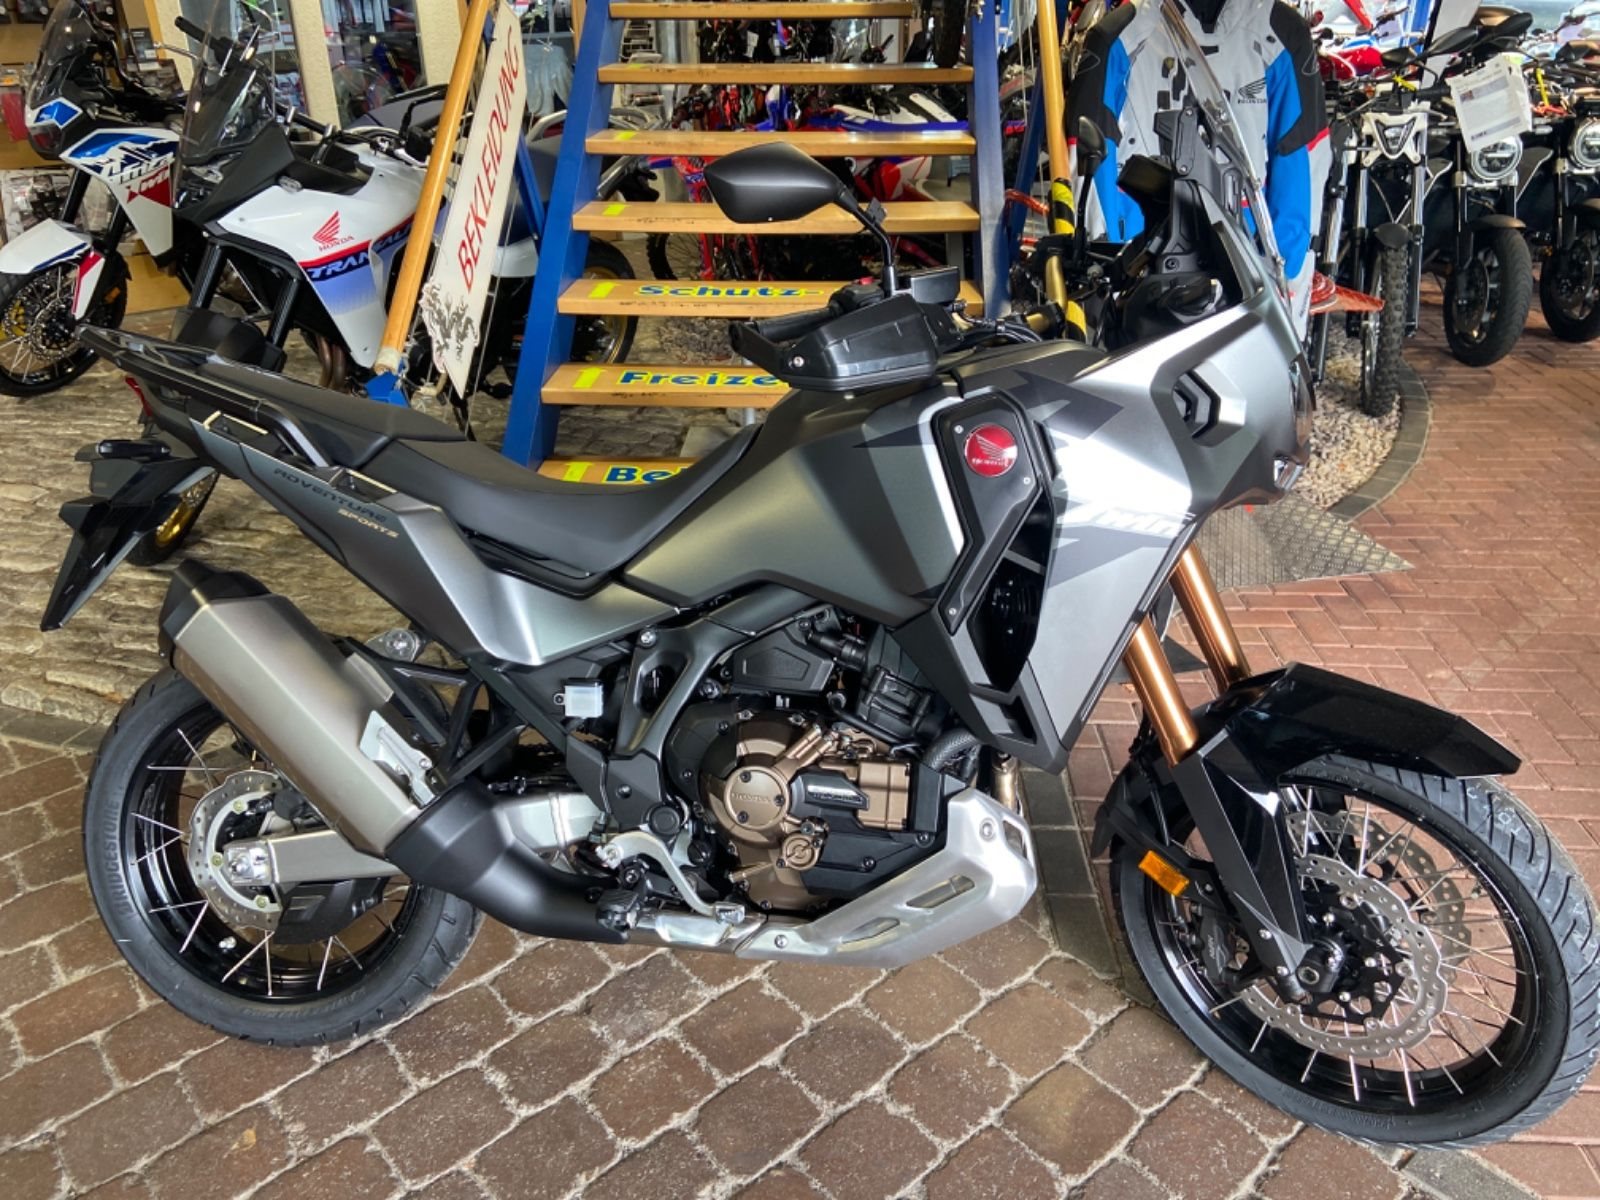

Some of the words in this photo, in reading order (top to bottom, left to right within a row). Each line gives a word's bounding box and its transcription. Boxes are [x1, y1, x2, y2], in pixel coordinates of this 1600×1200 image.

[458, 26, 520, 293] BEKLEIDUNG
[319, 235, 354, 251] HONDA
[637, 284, 822, 297] Schutz-
[618, 371, 780, 386] Freize
[605, 466, 674, 483] Be
[273, 467, 388, 524] ADVENTURE
[337, 507, 400, 538] SPORTS
[103, 800, 135, 916] BRIDGESTONE
